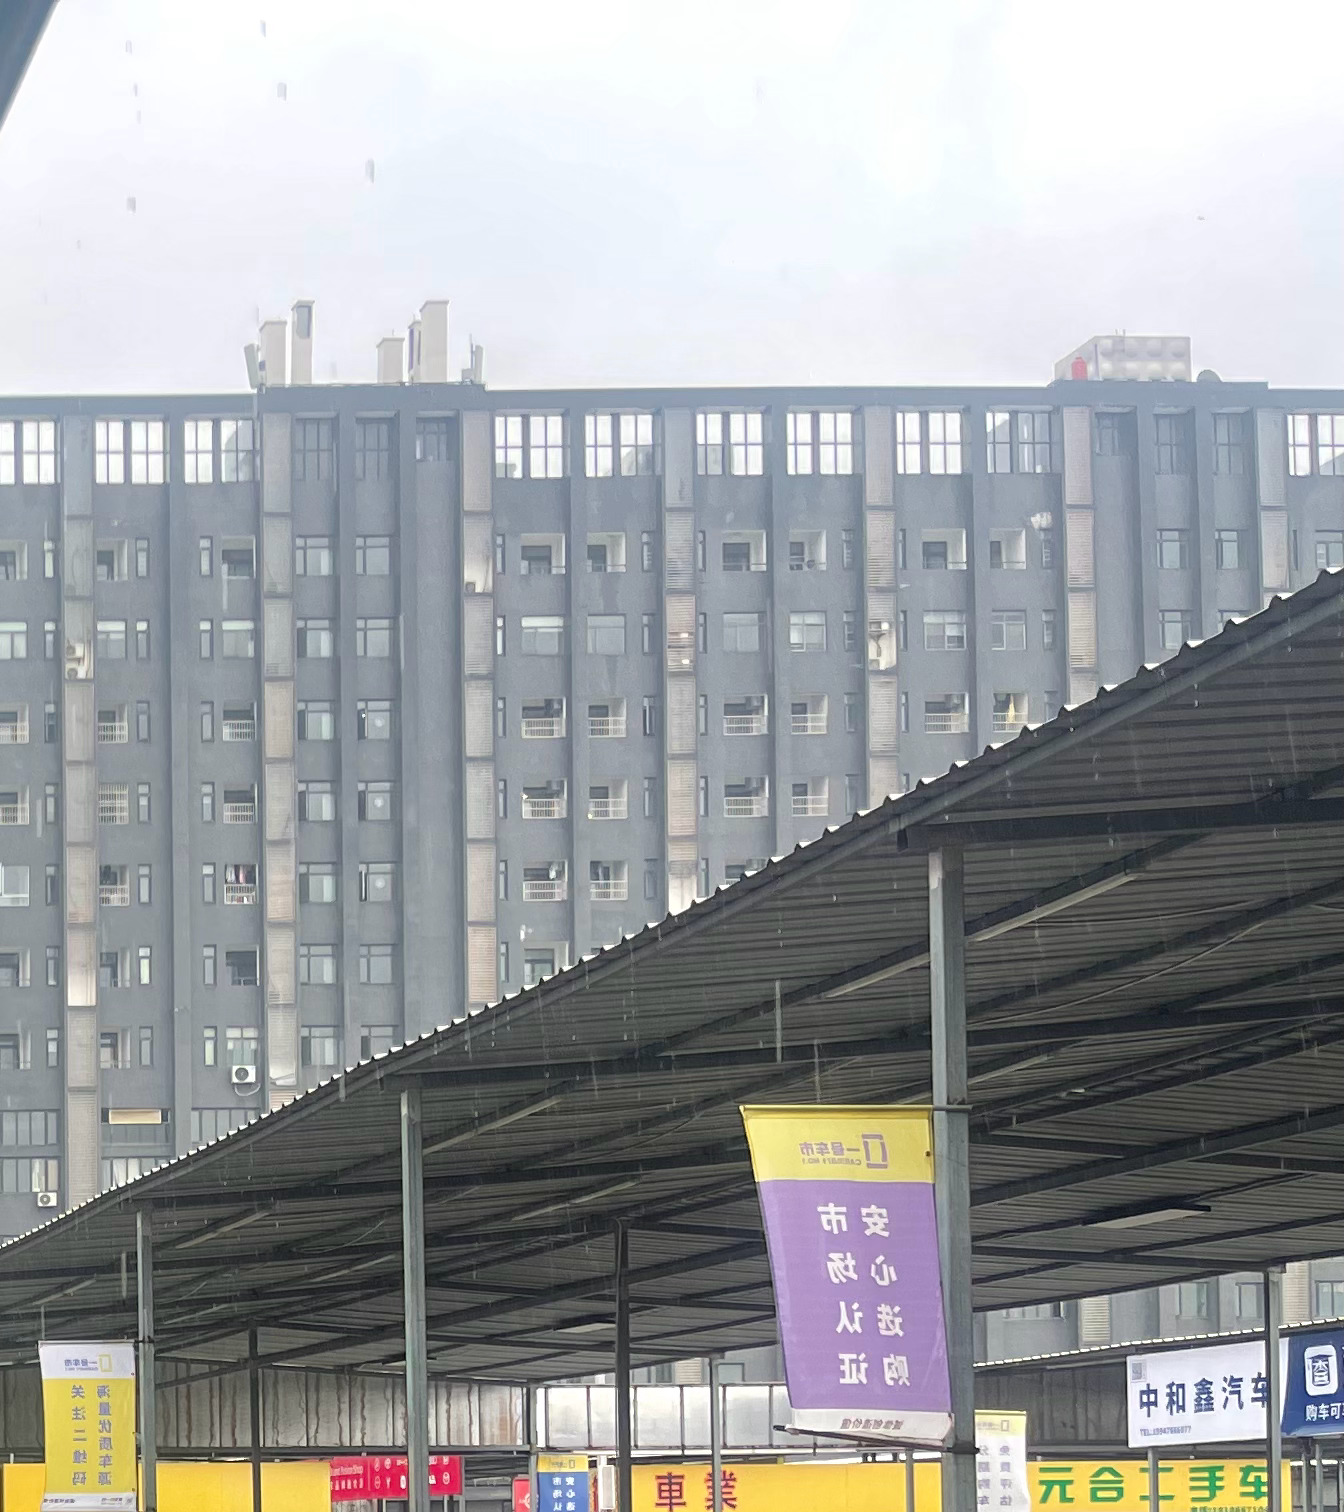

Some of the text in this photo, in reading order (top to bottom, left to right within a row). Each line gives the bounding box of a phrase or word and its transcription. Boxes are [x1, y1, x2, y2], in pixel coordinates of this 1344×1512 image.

[1139, 1371, 1268, 1418] 中和鑫汽车
[1305, 1402, 1344, 1423] 购车可
[1039, 1466, 1269, 1504] 元合二手车
